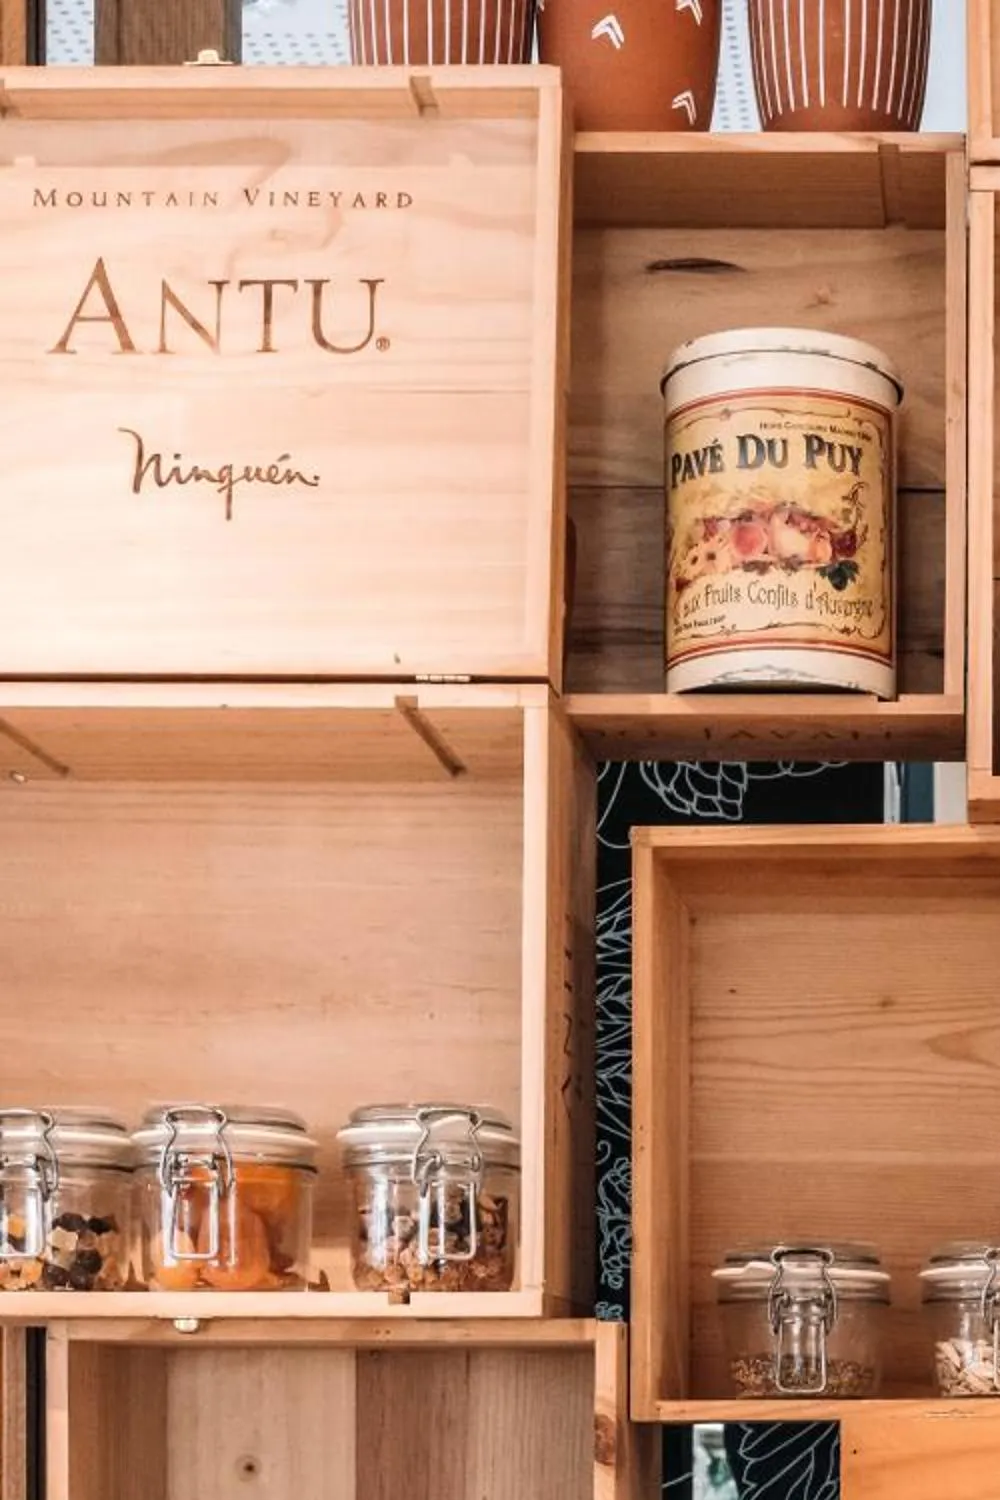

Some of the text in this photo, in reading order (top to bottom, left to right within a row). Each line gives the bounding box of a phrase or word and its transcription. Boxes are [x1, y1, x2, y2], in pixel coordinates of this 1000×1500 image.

[32, 188, 415, 210] MOUNTAIN VINEYARD
[670, 432, 864, 490] PAVÉ DU PUY
